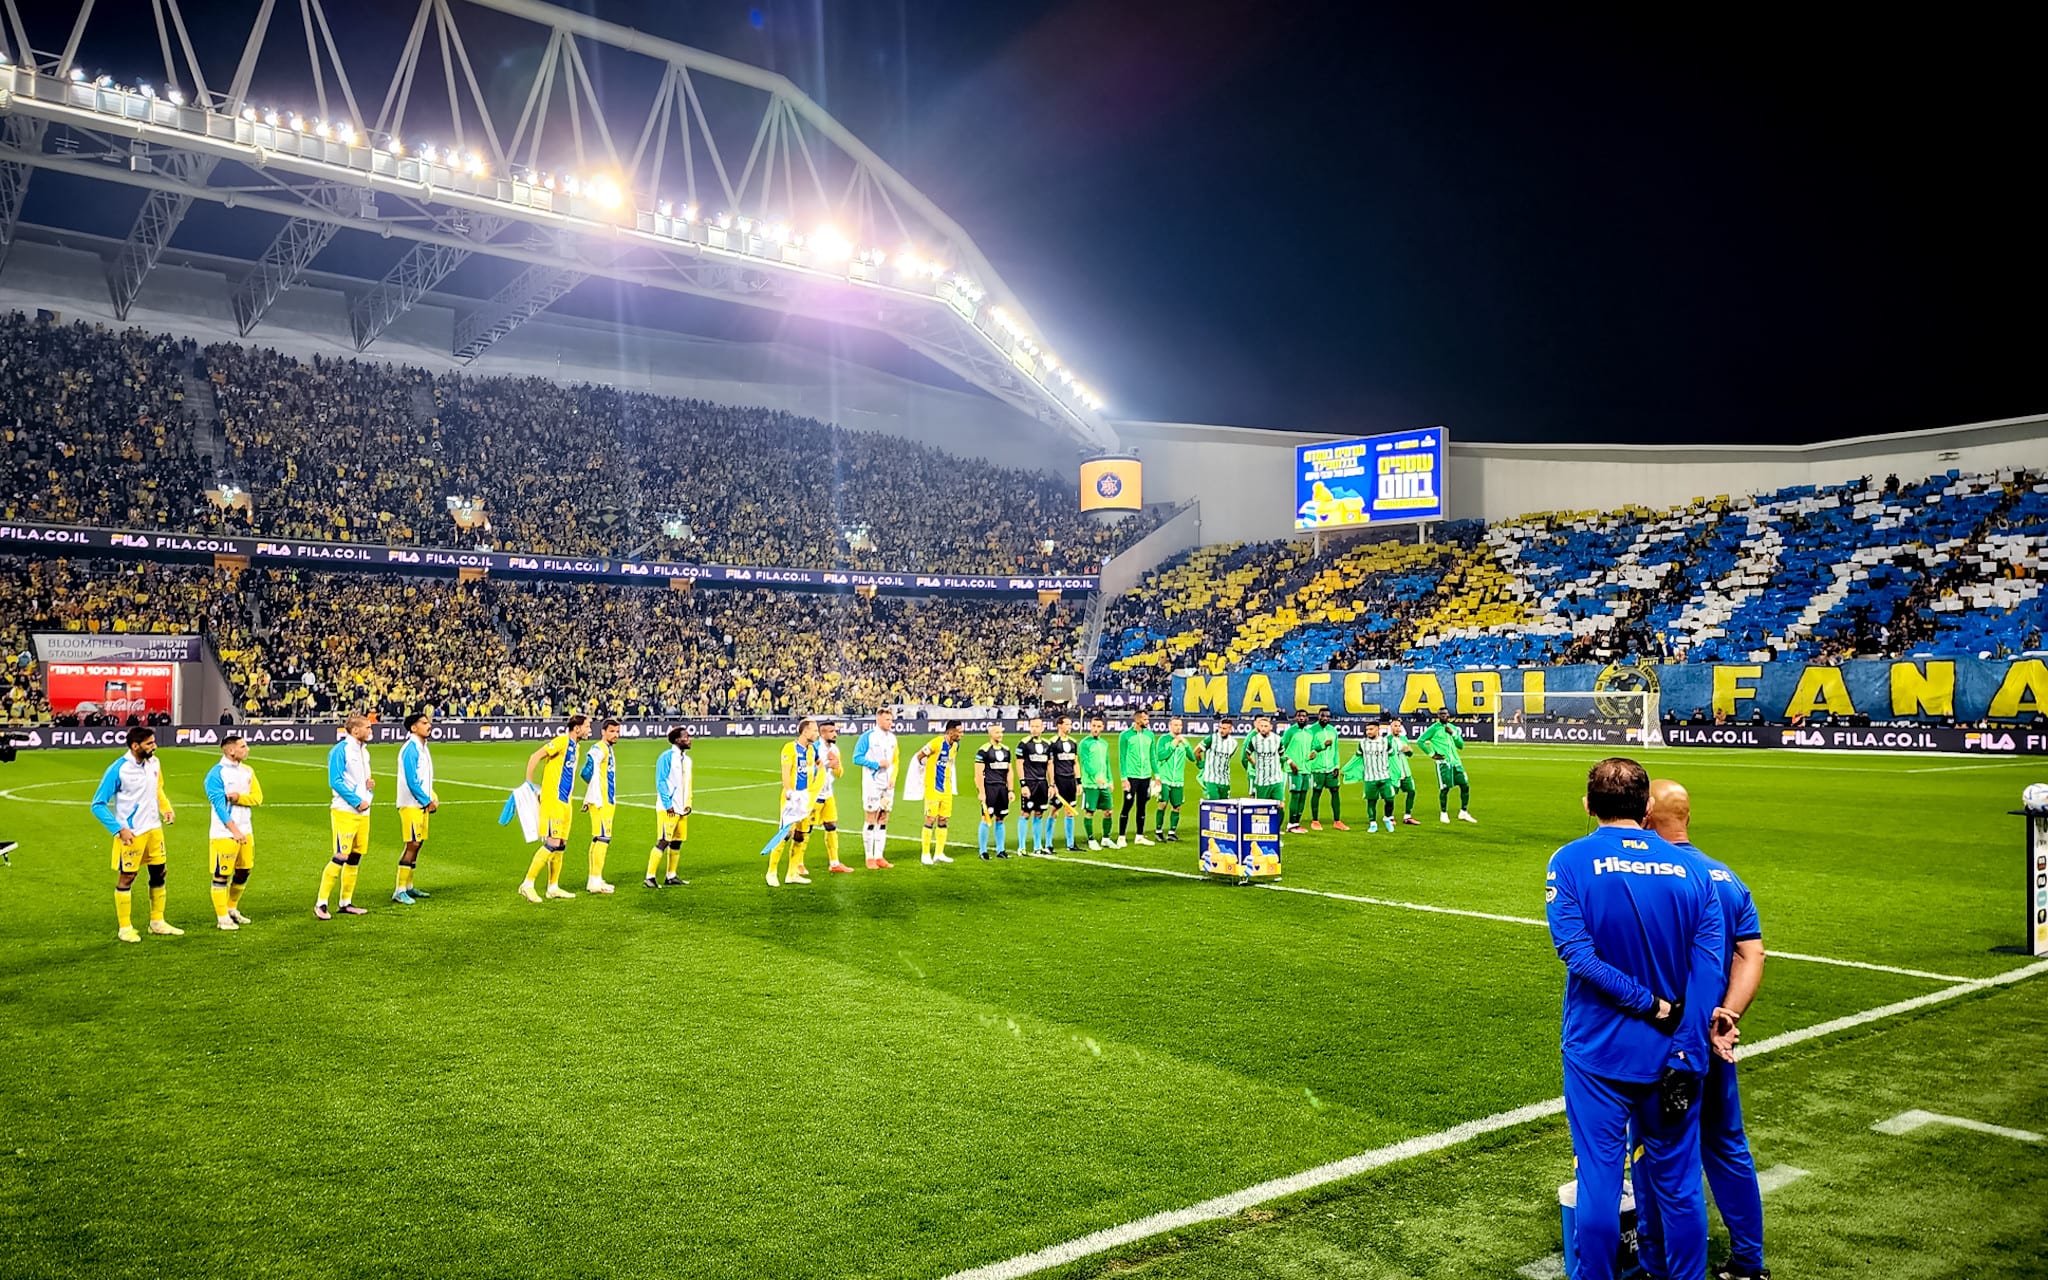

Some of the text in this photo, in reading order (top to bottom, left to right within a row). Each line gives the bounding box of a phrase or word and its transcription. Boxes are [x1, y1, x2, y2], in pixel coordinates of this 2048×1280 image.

[1378, 472, 1434, 499] בחום
[0, 527, 90, 543] FILA.CO.IL
[111, 534, 238, 553] FILA FILA.CO.IL
[257, 543, 371, 560] FILA FILA.CO.IL
[389, 551, 493, 567] FILA FILA.CO.IL
[509, 558, 599, 572] FILA FILA.CO.I
[621, 563, 712, 578] FILA FILA.CO.IL
[726, 569, 811, 582] FILA FILA.CO.IL
[823, 573, 904, 586] FILA FILA.CO.IL
[916, 577, 997, 588] FILA FILA.CO.IL
[1009, 579, 1093, 589] FILA FILA.CO.IL
[48, 639, 124, 648] BLOOMFIELD
[149, 639, 188, 649] אצטדיון
[48, 650, 92, 658] STADIUM
[131, 647, 188, 659] בלומפילד
[1183, 672, 1545, 714] MACCABI
[1712, 660, 2048, 717] FANA
[1095, 695, 1123, 706] FILA
[480, 726, 513, 739] FILA
[618, 725, 641, 737] ILA
[726, 724, 754, 735] FILA
[1187, 721, 1210, 732] FILA
[1497, 726, 1606, 741] FILA FILA.CO.IL
[51, 730, 128, 746] FILA.CO
[176, 729, 218, 744] FILA
[1669, 729, 1758, 744] FILA.CO.IL
[1782, 731, 1937, 748] FILA FILA.CO.IL
[1965, 732, 2016, 750] FILA
[1622, 839, 1649, 850] FILA
[1593, 857, 1686, 878] Hisense
